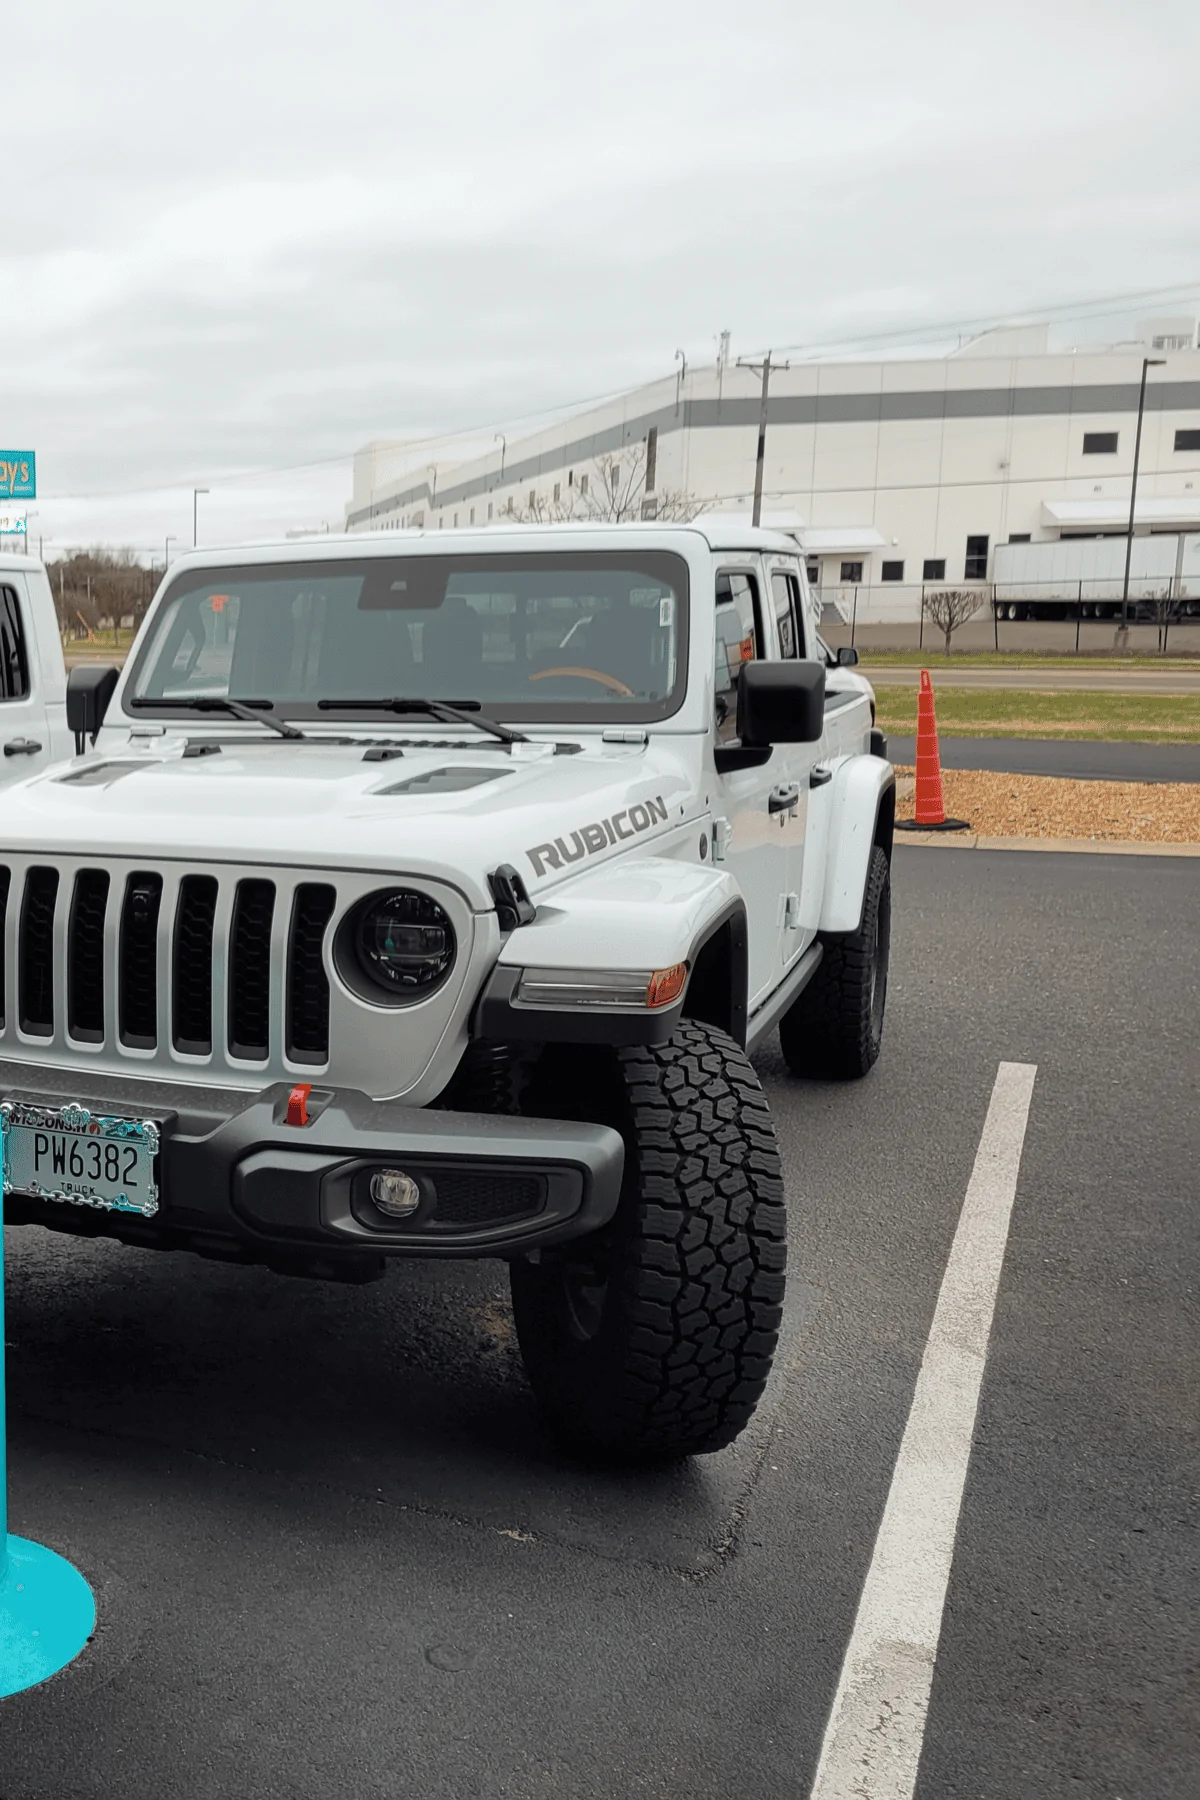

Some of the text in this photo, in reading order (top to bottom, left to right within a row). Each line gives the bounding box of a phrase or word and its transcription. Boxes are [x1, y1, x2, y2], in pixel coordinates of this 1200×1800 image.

[525, 796, 669, 878] RUBICON
[34, 1133, 138, 1187] PW6382
[60, 1182, 96, 1195] TRUCK
